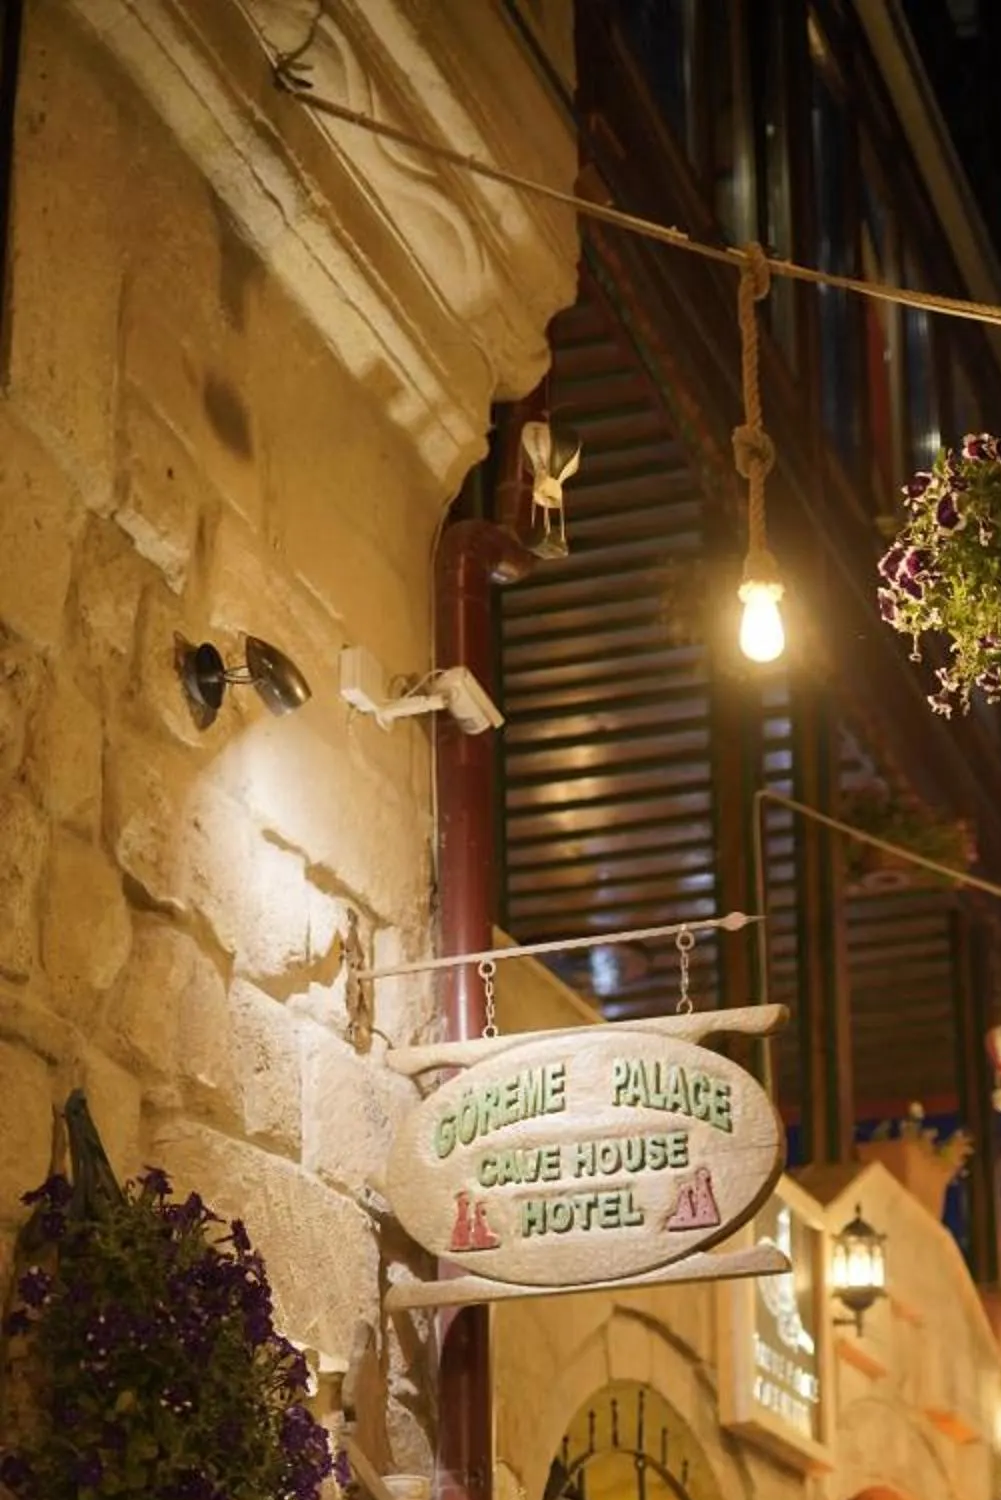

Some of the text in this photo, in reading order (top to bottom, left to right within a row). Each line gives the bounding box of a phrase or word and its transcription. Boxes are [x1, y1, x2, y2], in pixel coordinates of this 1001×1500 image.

[434, 1058, 733, 1158] GÖREME PALACE
[477, 1134, 690, 1187] CAVE HOUSE
[521, 1191, 644, 1237] HOTEL
